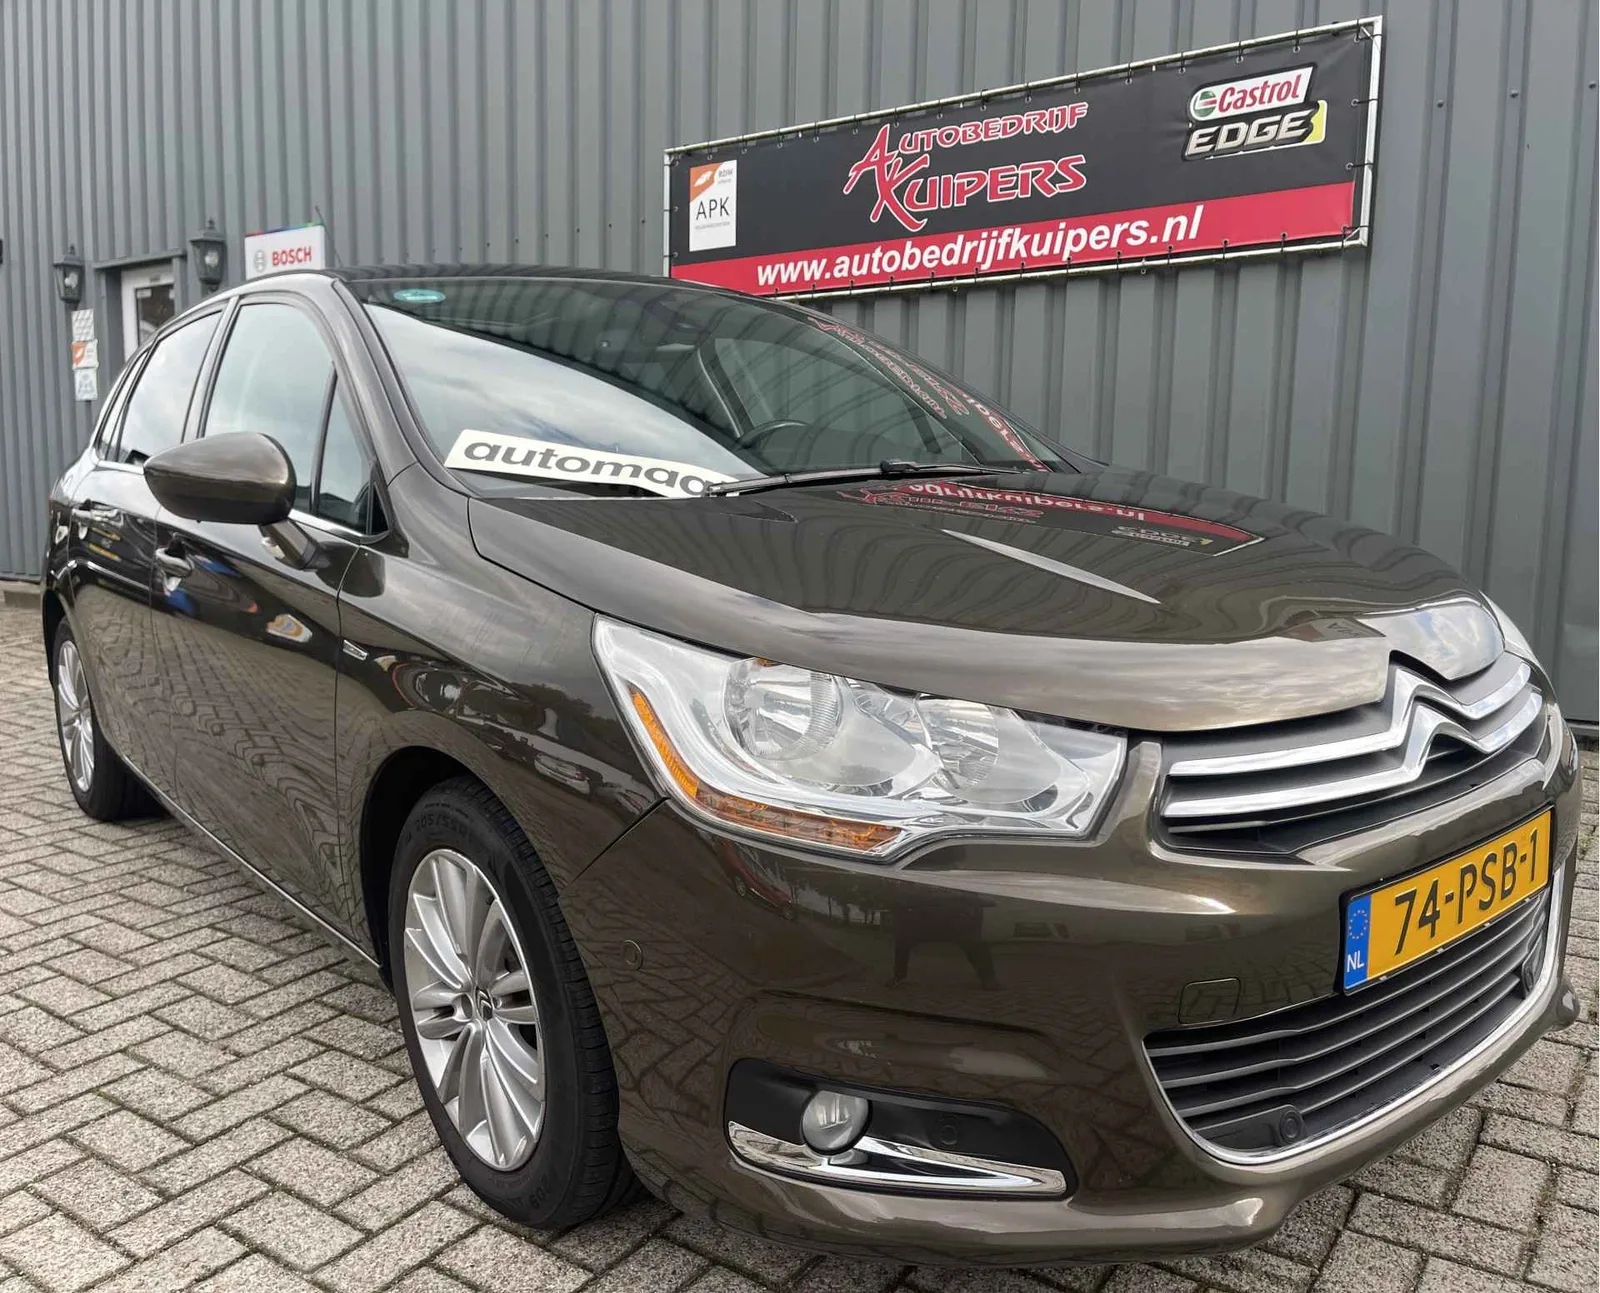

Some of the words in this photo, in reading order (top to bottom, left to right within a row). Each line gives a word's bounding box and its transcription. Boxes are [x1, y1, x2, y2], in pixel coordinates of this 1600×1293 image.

[1218, 74, 1302, 113] Castrol
[843, 101, 1089, 195] AUTOBEDRIJF
[1186, 108, 1312, 156] EDGE
[695, 196, 730, 220] APK
[870, 153, 1087, 233] KUIPERS
[272, 246, 312, 266] BOSCH
[757, 204, 1204, 286] www.autobedrijfkuipers.nl
[1394, 827, 1538, 956] 74-PSB-1
[1347, 950, 1365, 973] NL
